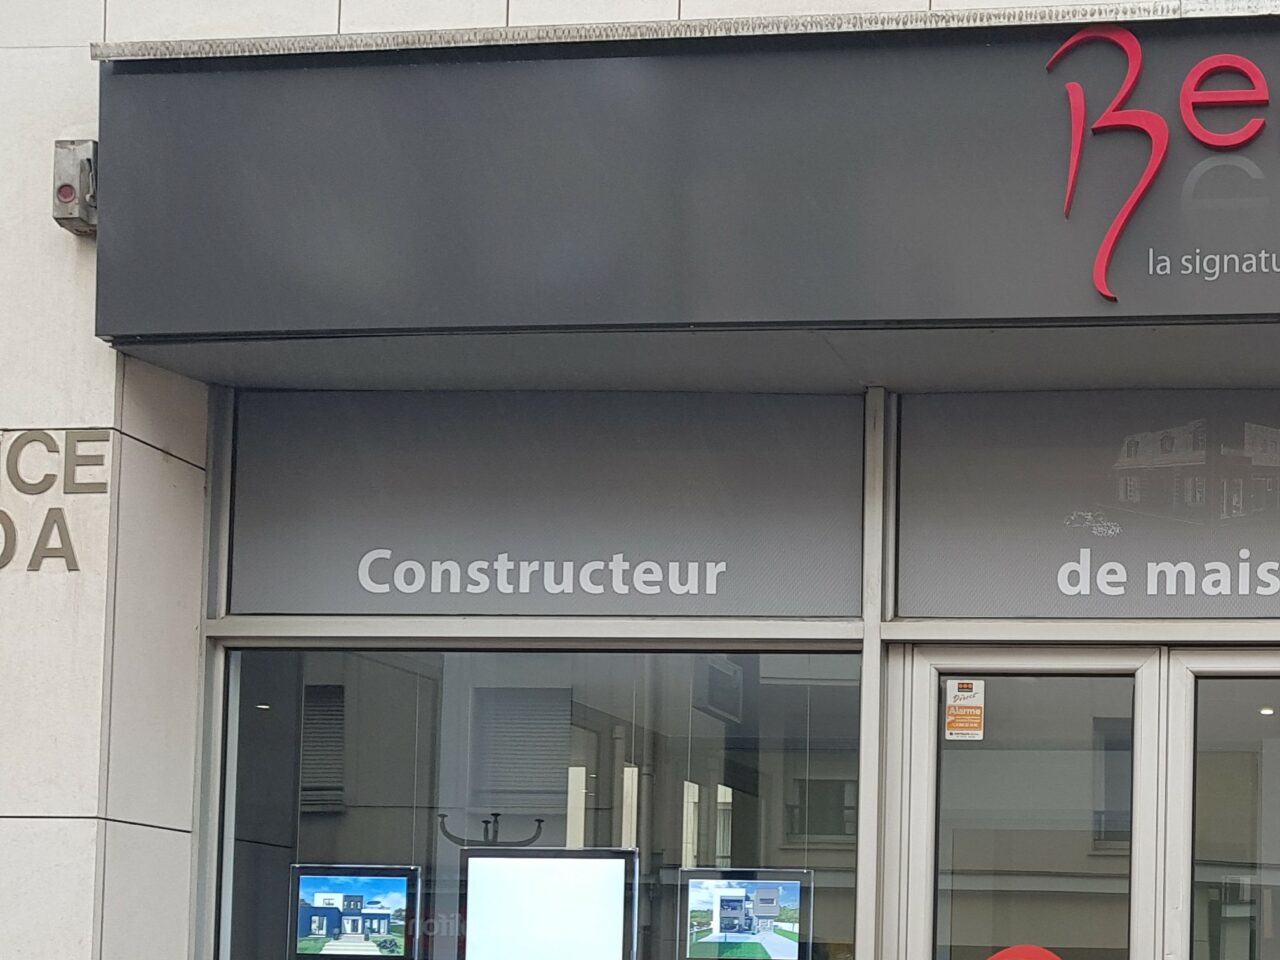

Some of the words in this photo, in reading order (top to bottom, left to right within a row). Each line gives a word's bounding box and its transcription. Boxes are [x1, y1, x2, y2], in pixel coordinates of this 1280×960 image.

[1148, 248, 1171, 275] la
[0, 430, 110, 495] CE
[357, 547, 728, 595] Constructeur
[1057, 548, 1128, 595] de
[949, 706, 981, 715] Alarme
